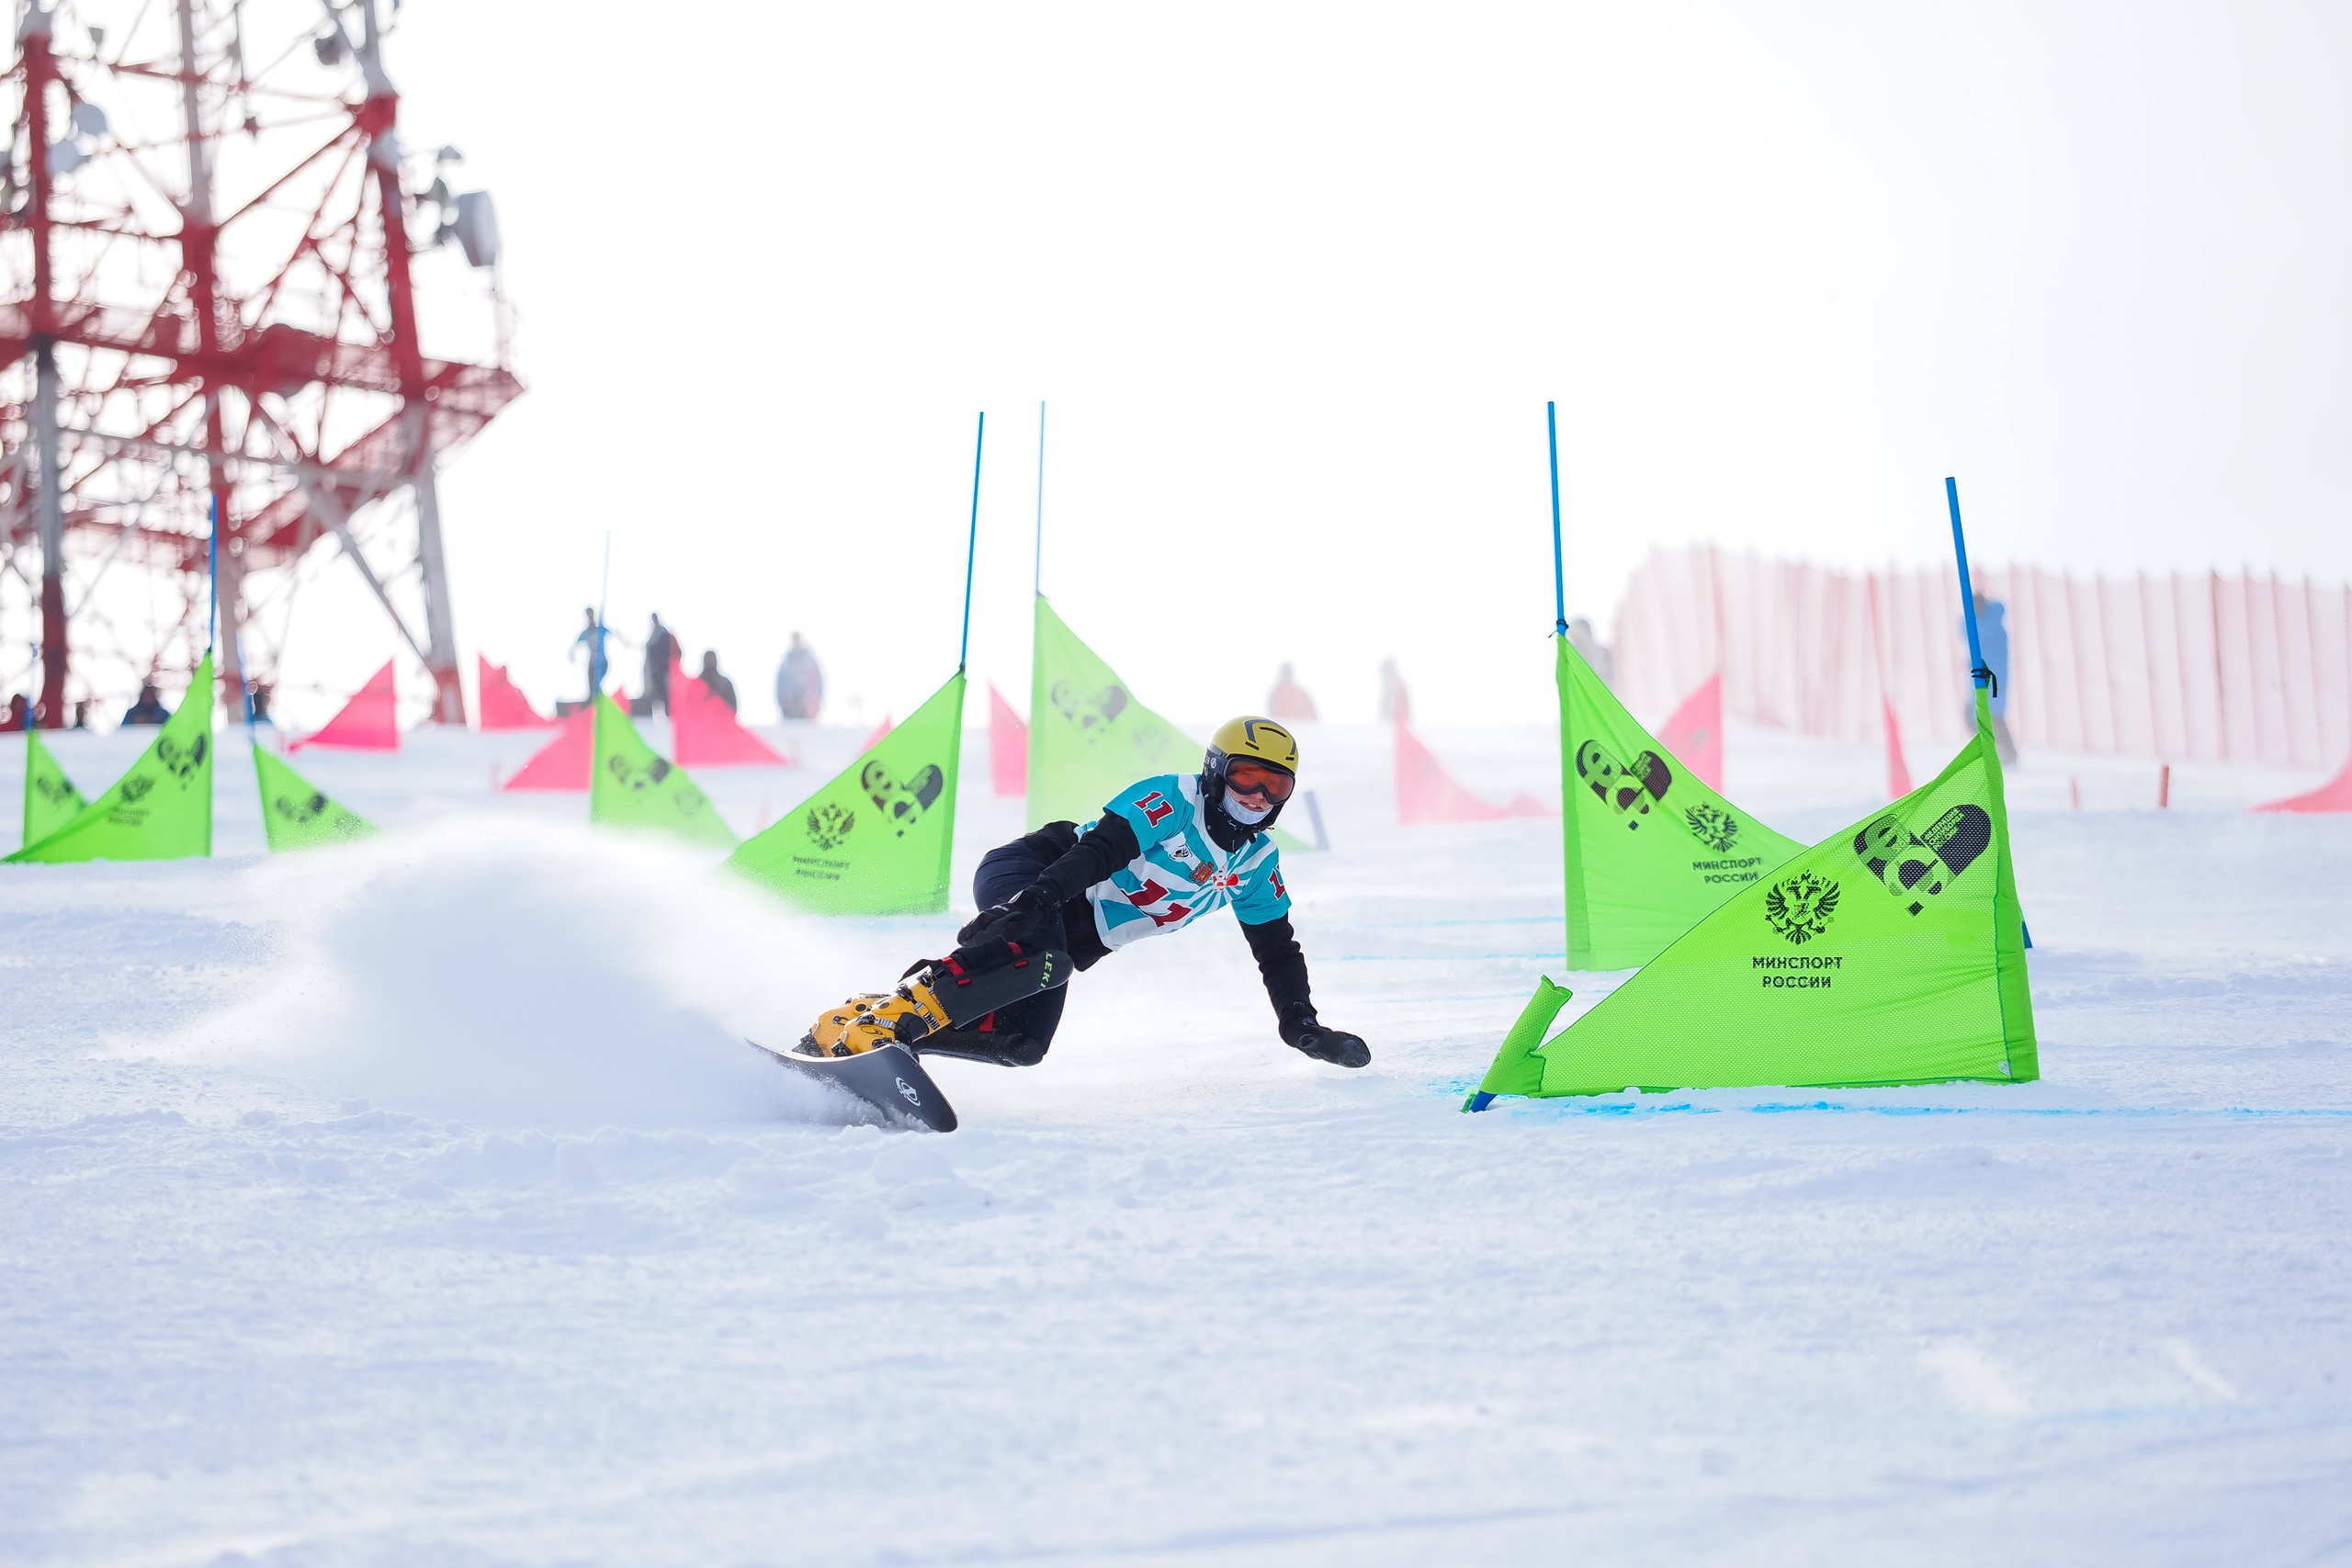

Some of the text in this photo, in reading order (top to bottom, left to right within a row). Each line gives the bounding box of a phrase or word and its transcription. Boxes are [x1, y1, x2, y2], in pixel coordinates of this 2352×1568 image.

[1132, 791, 1174, 828] 11
[1692, 857, 1762, 871] МИНСПОРТ
[1268, 863, 1286, 900] 1
[1703, 872, 1759, 884] РОССИИ
[1120, 877, 1193, 928] 11
[1040, 951, 1053, 988] LEKI
[1752, 956, 1843, 969] МИНСПОРТ
[1762, 976, 1831, 988] РОССИИ
